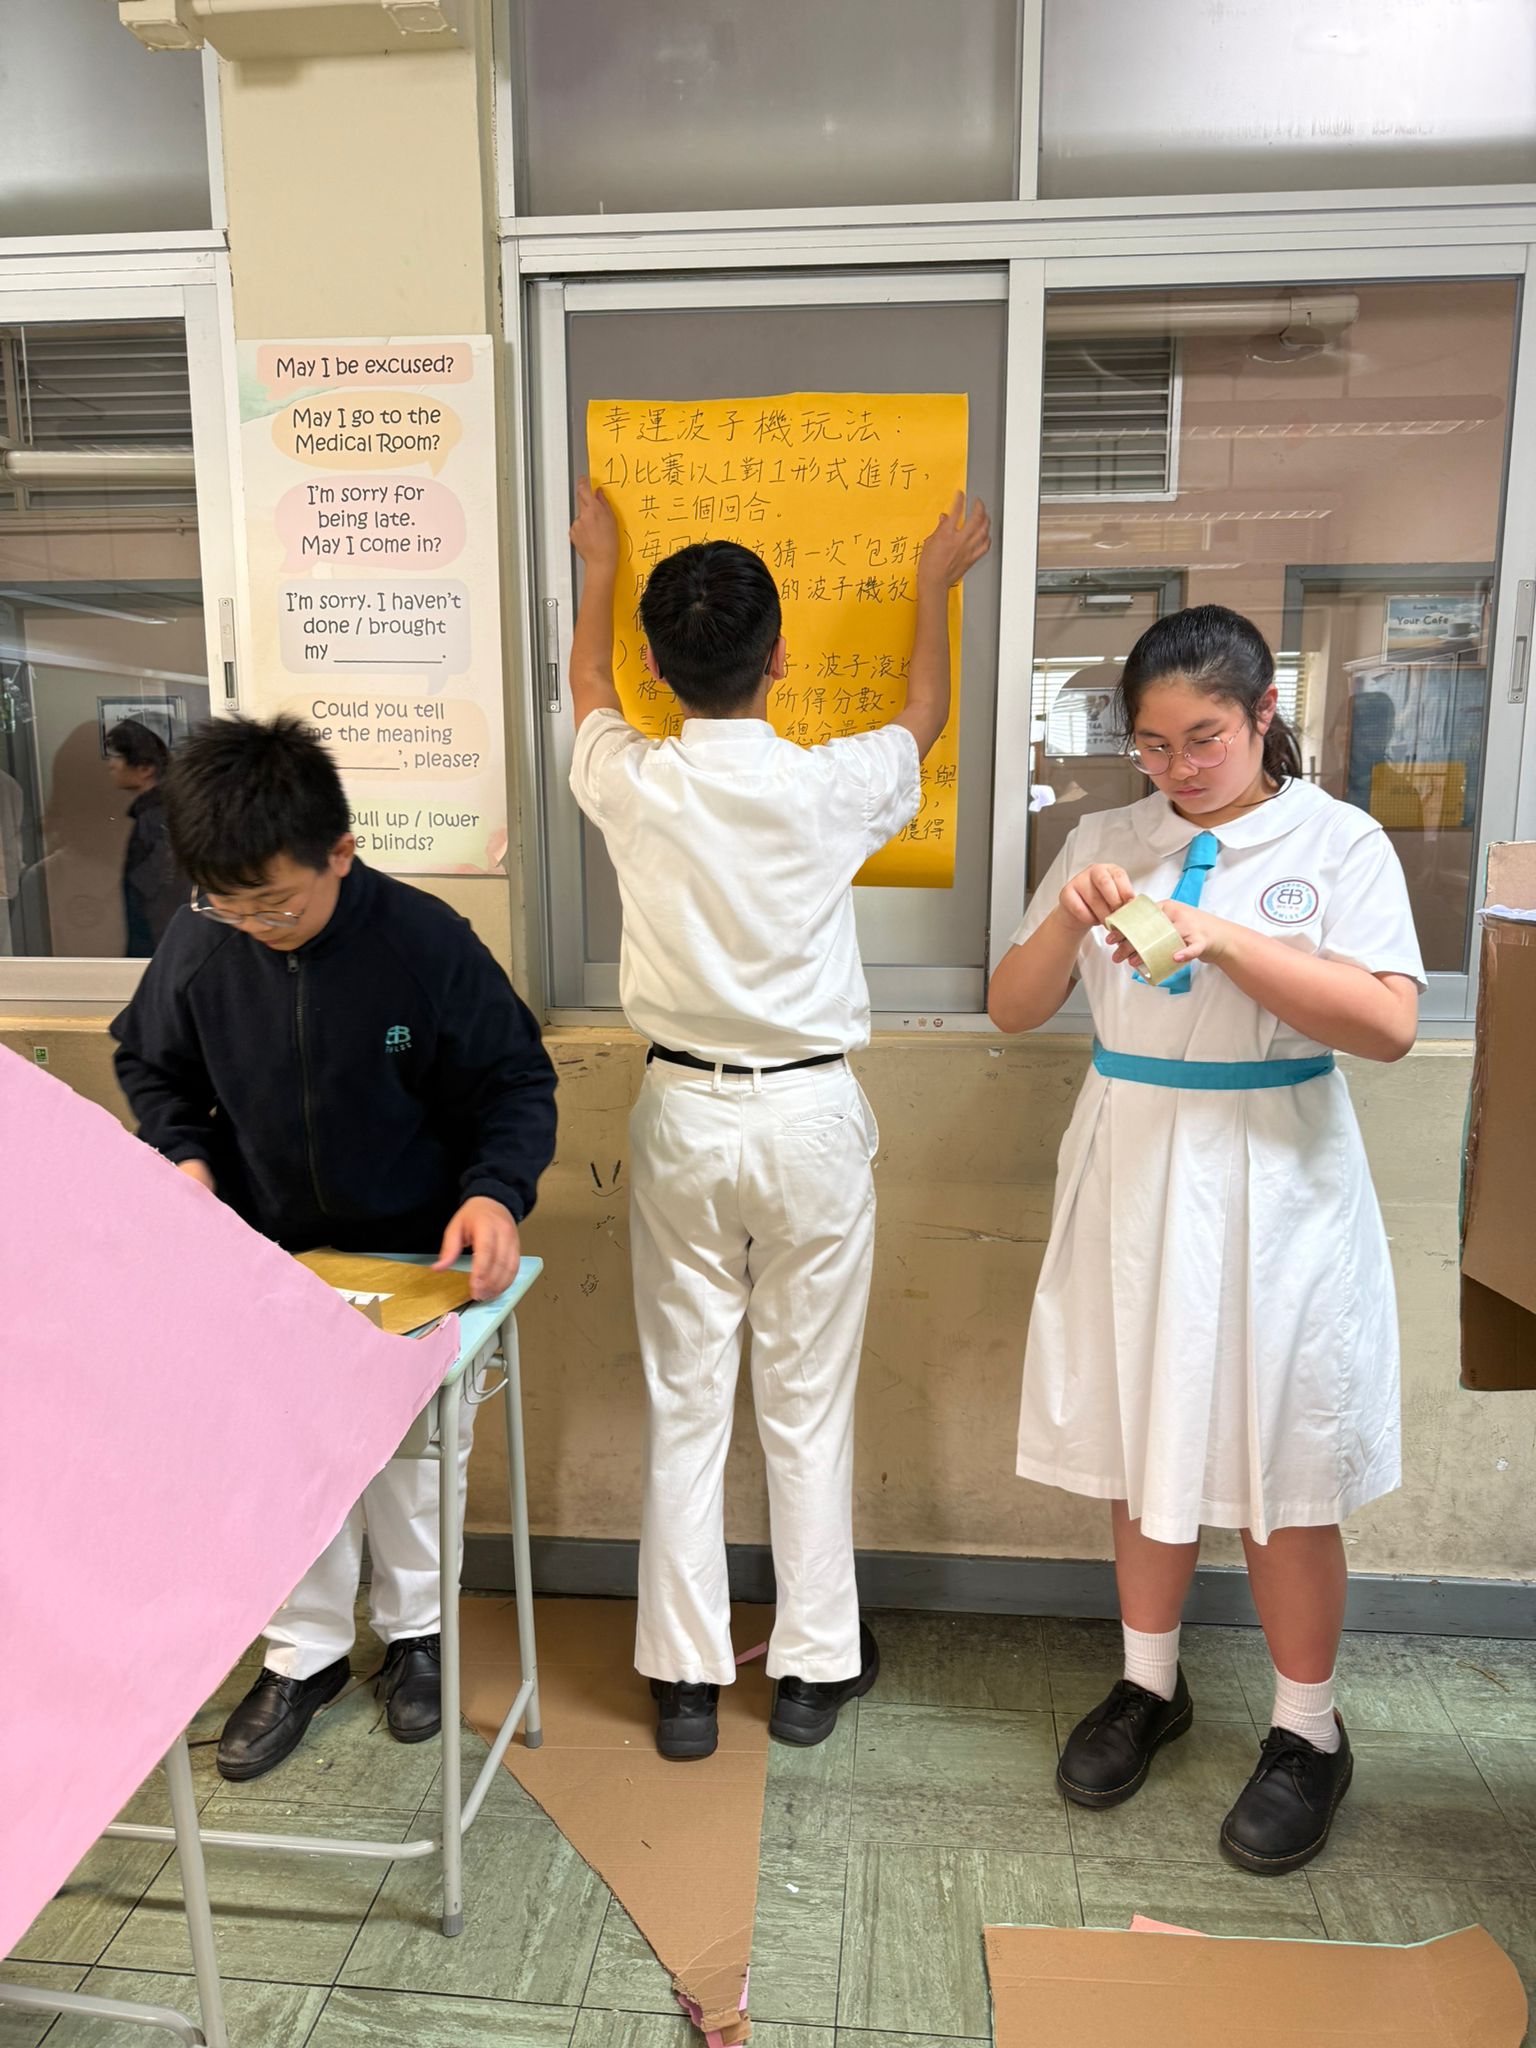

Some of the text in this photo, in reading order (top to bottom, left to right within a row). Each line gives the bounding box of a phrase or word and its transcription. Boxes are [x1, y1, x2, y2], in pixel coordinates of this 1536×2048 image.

[276, 354, 454, 379] May I be excused?
[292, 406, 442, 430] May I go to the
[295, 432, 441, 455] Medical Room?
[306, 484, 425, 506] I'm sorry for
[317, 510, 416, 530] being late.
[301, 534, 442, 556] May I come in?
[285, 591, 462, 613] I'm sorry. I haven't
[303, 616, 447, 637] done / brought
[1396, 614, 1450, 626] Your Cafe
[304, 643, 329, 661] my
[311, 700, 445, 720] Could you tell
[337, 724, 371, 743] the
[376, 726, 453, 745] meaning
[414, 751, 480, 769] please?
[386, 811, 410, 829] up
[414, 809, 422, 828] /
[428, 810, 480, 829] lower
[371, 833, 434, 851] blinds?
